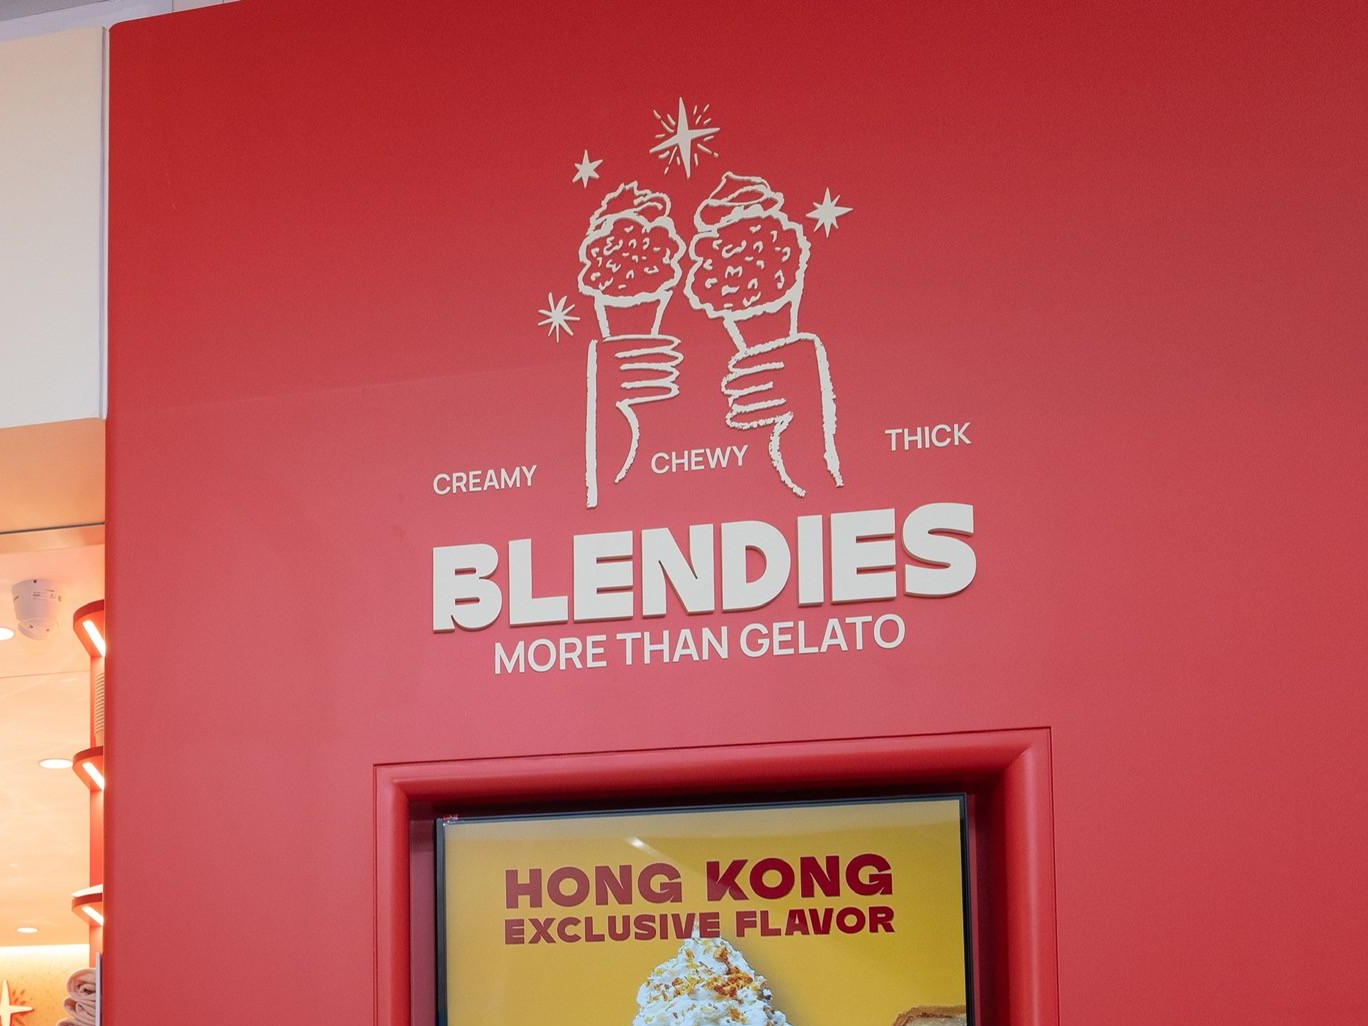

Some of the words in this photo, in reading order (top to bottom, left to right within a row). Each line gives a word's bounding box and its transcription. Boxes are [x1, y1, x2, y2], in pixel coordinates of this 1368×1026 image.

[884, 422, 972, 452] THICK
[650, 444, 748, 475] CHEWY
[433, 464, 537, 496] CREAMY
[432, 502, 978, 634] BLENDIES
[493, 634, 607, 675] MORE
[616, 626, 729, 666] THAN
[739, 613, 906, 657] GELATO
[504, 862, 683, 909] HONG
[706, 852, 894, 902] KONG
[504, 911, 721, 945] EXCLUSIVE
[735, 906, 896, 938] FLAVOR
